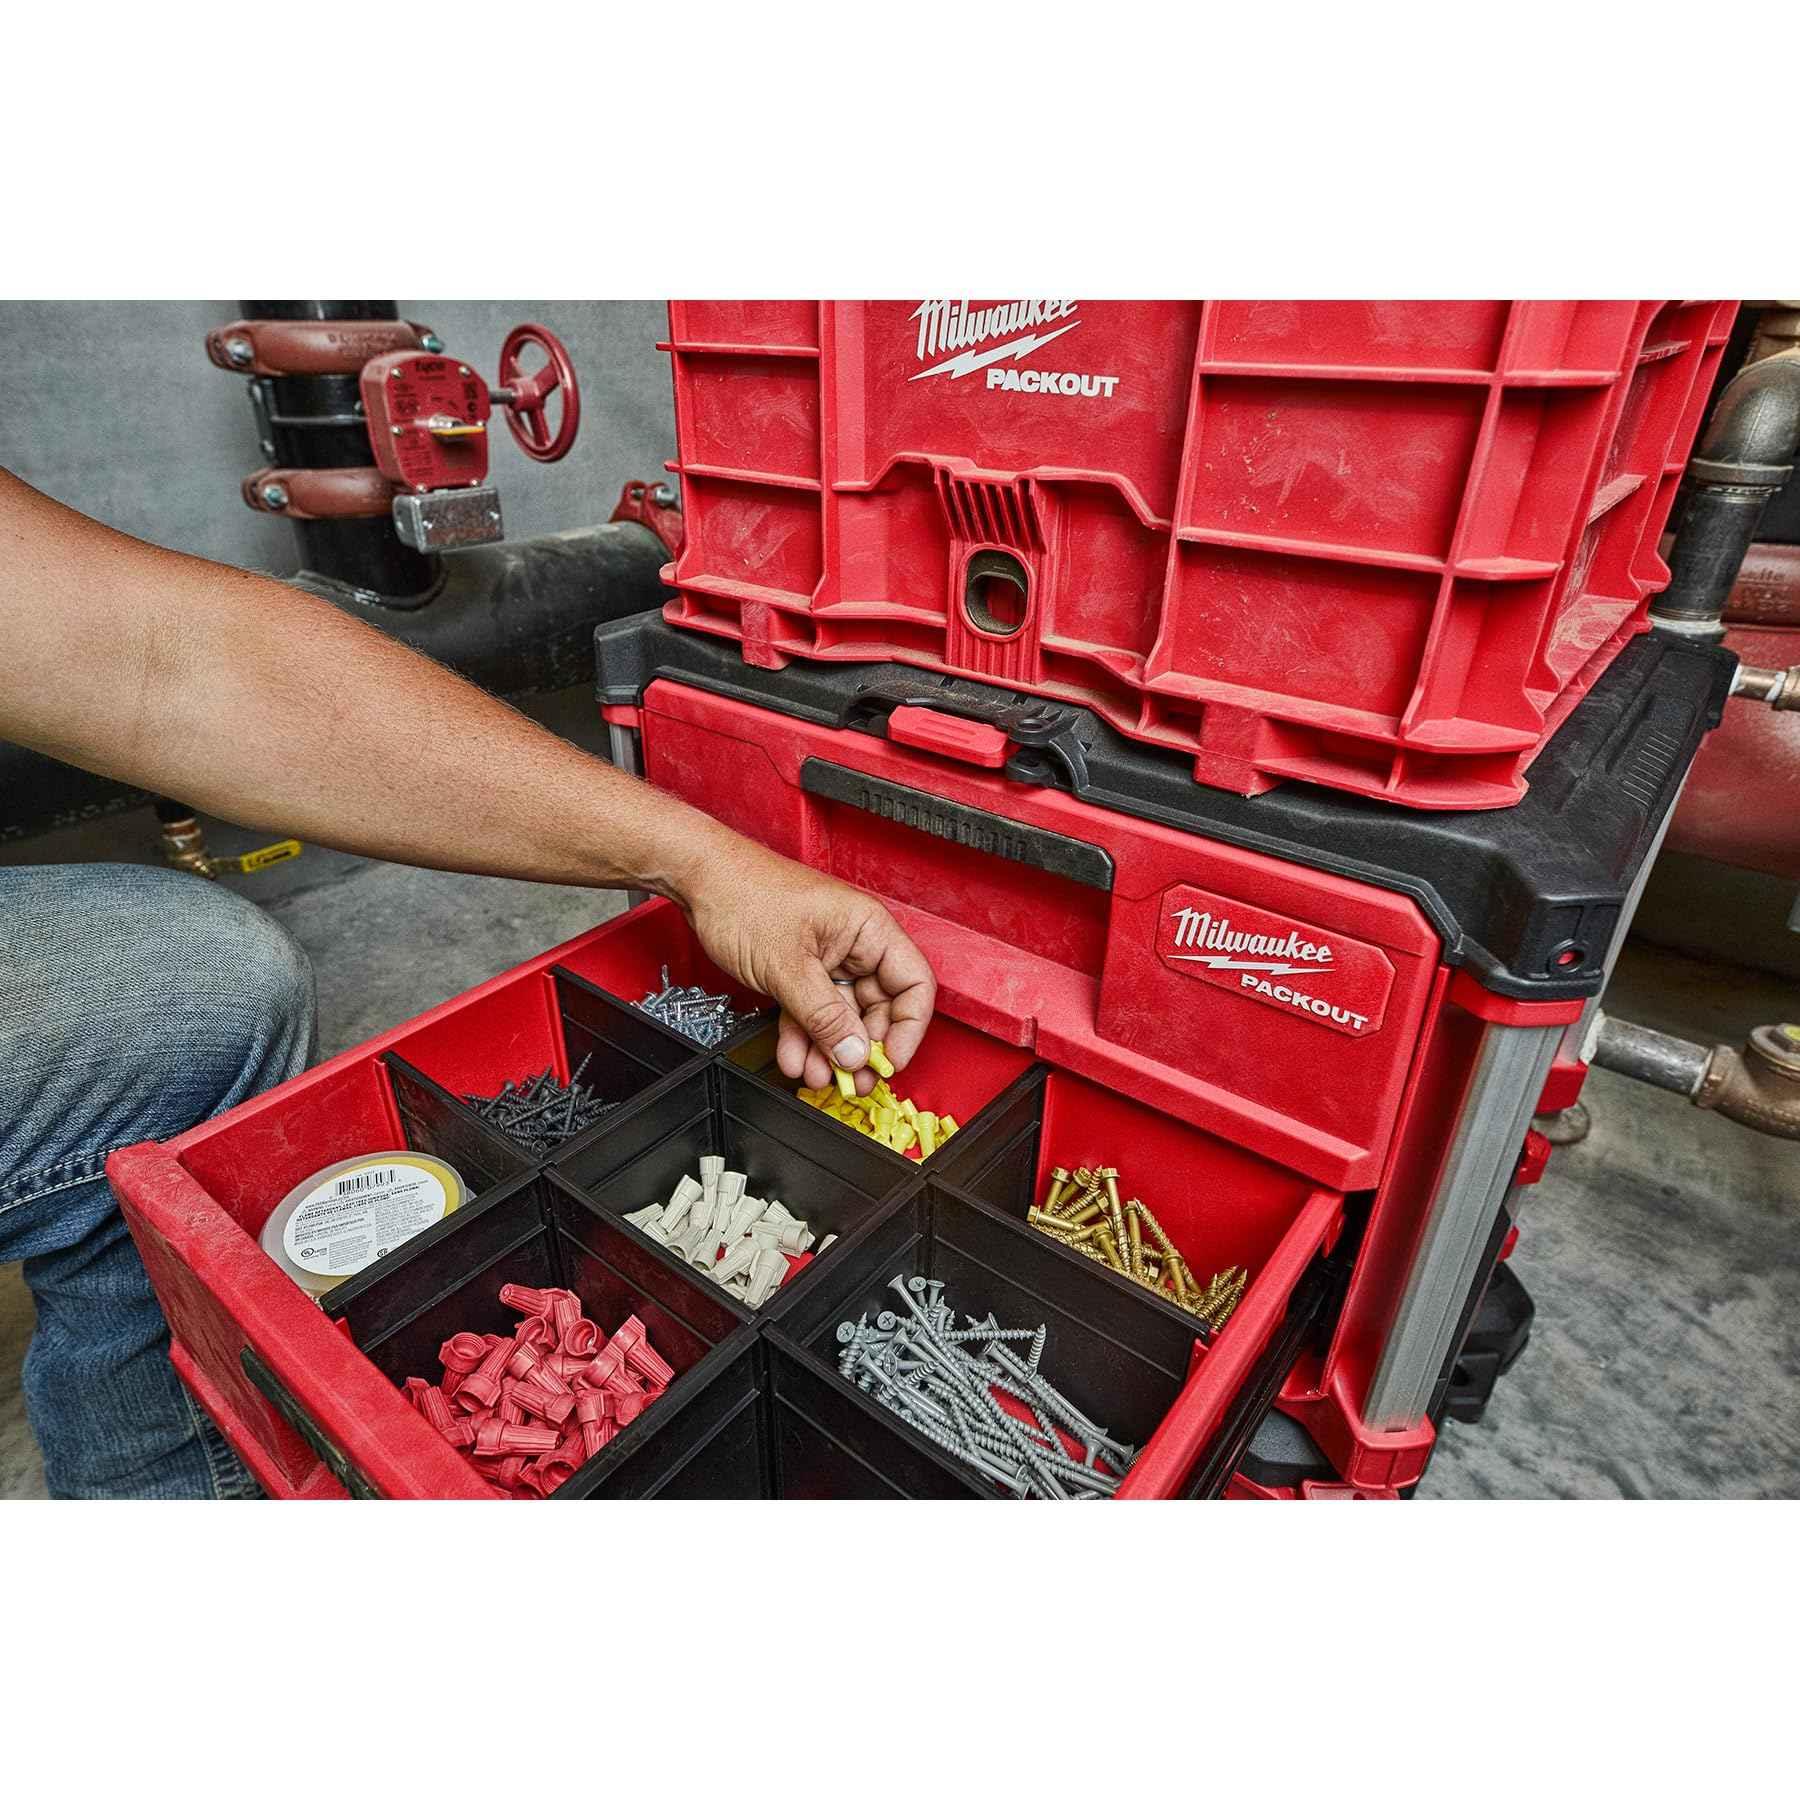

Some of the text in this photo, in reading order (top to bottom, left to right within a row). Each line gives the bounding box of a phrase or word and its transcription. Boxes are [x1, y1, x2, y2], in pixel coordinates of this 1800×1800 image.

[908, 300, 1078, 361] Milwaukee
[986, 368, 1120, 397] PACKOUT
[1170, 907, 1334, 963] Milwaukee
[1240, 973, 1369, 1030] PACKOUT
